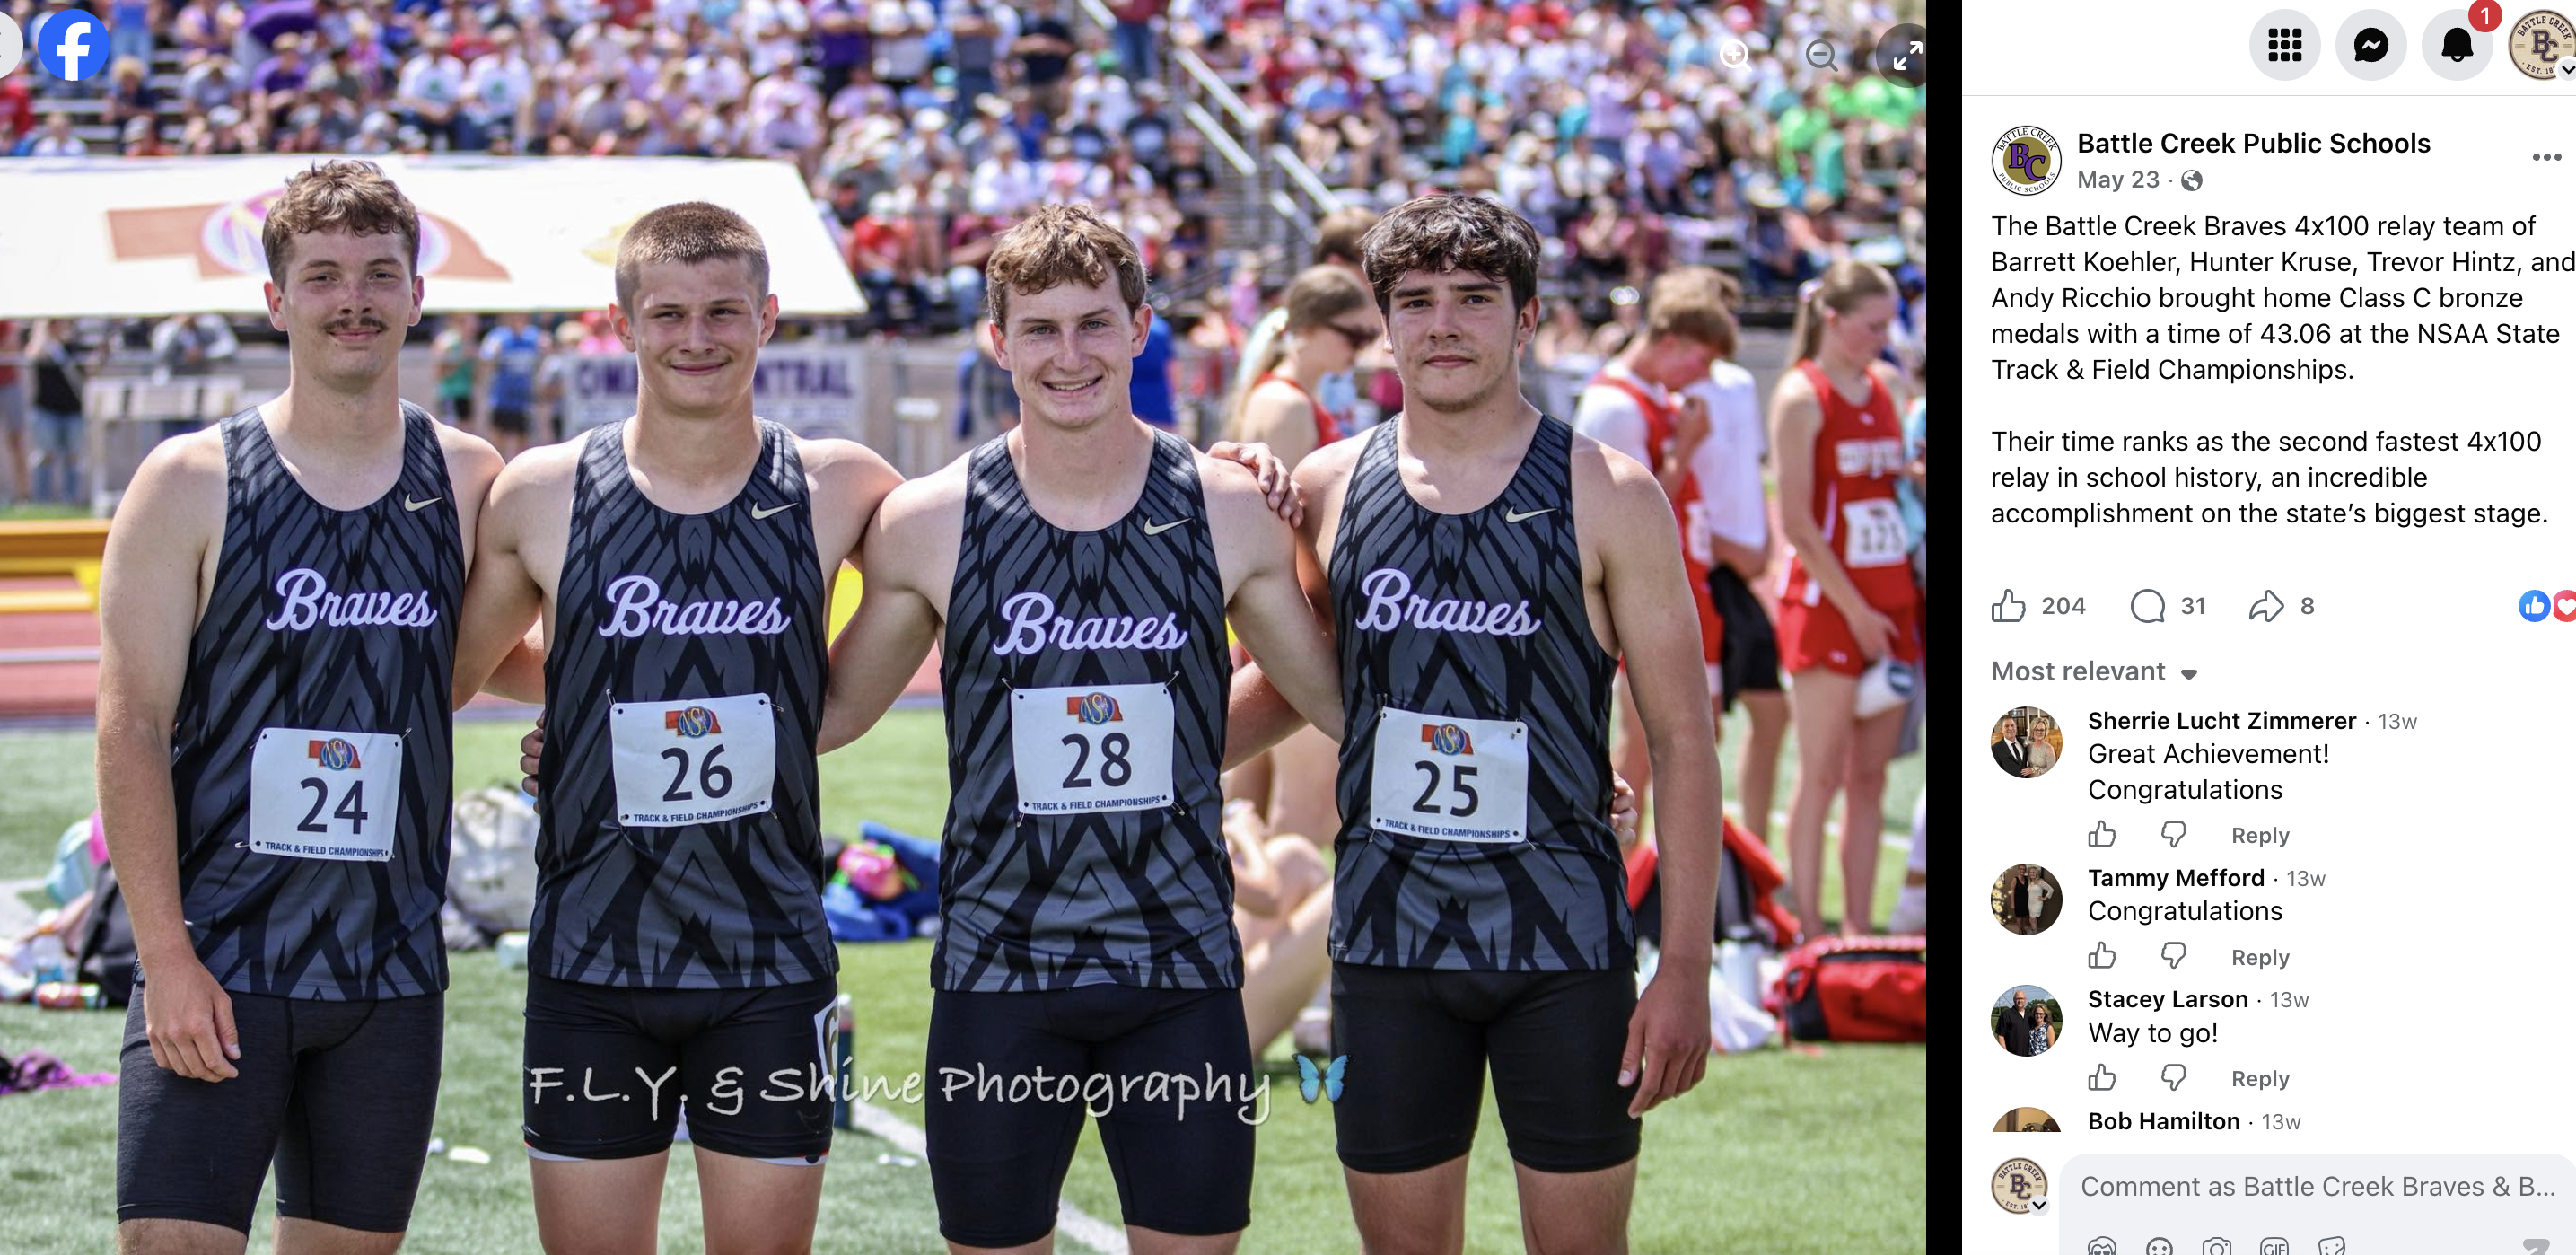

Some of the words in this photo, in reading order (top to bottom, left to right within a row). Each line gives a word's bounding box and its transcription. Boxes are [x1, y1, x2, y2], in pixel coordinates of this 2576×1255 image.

[2481, 7, 2489, 25] 1
[2517, 15, 2546, 37] BATTLE
[2549, 17, 2572, 40] CREEK
[57, 22, 91, 81] f
[2531, 29, 2559, 63] BC
[2526, 64, 2542, 75] EST.
[2545, 66, 2555, 75] 18
[1996, 127, 2028, 152] BATTLE
[2030, 128, 2057, 151] CREEK
[2079, 132, 2152, 154] Battle
[2161, 132, 2236, 154] Creek
[2245, 132, 2321, 154] Public
[2330, 132, 2431, 154] Schools
[2009, 143, 2046, 181] BC
[1999, 172, 2022, 192] PUBLIC
[2024, 171, 2055, 193] SCHOOLS
[2079, 171, 2124, 192] May
[2132, 171, 2160, 188] 23
[1992, 215, 2037, 236] The
[2047, 215, 2116, 236] Battle
[2125, 215, 2196, 236] Creek
[2205, 215, 2286, 236] Braves
[2295, 215, 2369, 236] 4x100
[2379, 215, 2435, 241] relay
[2443, 217, 2503, 236] team
[2513, 215, 2537, 236] of
[1993, 251, 2075, 272] Barrett
[2085, 251, 2180, 276] Koehler,
[2191, 252, 2274, 272] Hunter
[2282, 252, 2357, 276] Kruse,
[2367, 252, 2444, 272] Trevor
[2453, 250, 2521, 276] Hintz,
[2531, 251, 2575, 272] and
[1992, 287, 2054, 312] Andy
[2063, 286, 2151, 308] Ricchio
[2160, 287, 2255, 312] brought
[2265, 287, 2331, 308] home
[2340, 287, 2405, 308] Class
[2414, 287, 2431, 308] C
[2440, 287, 2523, 308] bronze
[1993, 323, 2079, 344] medals
[2088, 322, 2136, 343] with
[2146, 329, 2159, 344] a
[2168, 322, 2220, 344] time
[2229, 323, 2252, 344] of
[2261, 323, 2330, 344] 43.06
[2340, 325, 2362, 344] at
[2370, 323, 2409, 344] the
[2419, 323, 2488, 344] NSAA
[2497, 323, 2560, 344] State
[1992, 359, 2058, 380] Track
[2067, 359, 2084, 380] &
[2094, 358, 2149, 380] Field
[2159, 358, 2353, 384] Championships.
[1992, 430, 2054, 452] Their
[2062, 430, 2114, 452] time
[2124, 431, 2188, 452] ranks
[2197, 436, 2223, 452] as
[2231, 431, 2270, 452] the
[2279, 431, 2367, 452] second
[2376, 431, 2458, 452] fastest
[2467, 431, 2541, 452] 4x100
[1993, 467, 2049, 492] relay
[2058, 466, 2077, 487] in
[2087, 467, 2165, 487] school
[2176, 466, 2261, 492] history,
[2272, 472, 2299, 487] an
[2309, 466, 2427, 487] incredible
[1992, 502, 2193, 528] accomplishment
[2202, 508, 2230, 523] on
[2239, 503, 2277, 523] the
[2287, 504, 2366, 523] state’s
[2376, 503, 2466, 528] biggest
[2474, 505, 2547, 528] stage.
[267, 567, 438, 631] Braves
[598, 575, 792, 638] Braves
[1355, 567, 1542, 636] Braves
[2043, 597, 2086, 615] 204
[2181, 597, 2204, 614] 31
[2301, 597, 2314, 614] 8
[993, 592, 1188, 656] Braves
[1993, 662, 2055, 680] Most
[2063, 661, 2165, 680] relevant
[2089, 711, 2169, 730] Sherrie
[2178, 711, 2240, 730] Lucht
[2248, 711, 2357, 730] Zimmerer
[2379, 714, 2417, 729] 13w
[1061, 732, 1132, 789] 28
[2090, 743, 2155, 764] Great
[2163, 742, 2328, 764] Achievement!
[660, 743, 732, 803] 26
[1412, 760, 1479, 818] 25
[2090, 779, 2282, 804] Congratulations
[297, 777, 368, 835] 24
[634, 813, 661, 823] TRACK
[662, 813, 670, 823] &
[670, 812, 694, 822] FIELD
[696, 801, 758, 821] CHAMPIONSHIPS
[1032, 802, 1059, 812] TRACK
[1061, 802, 1068, 811] &
[1070, 800, 1092, 810] FIELD
[1095, 795, 1161, 809] CHAMPIONSHIPS
[1385, 819, 1409, 832] TRACK
[1410, 823, 1417, 833] &
[1418, 825, 1440, 836] FIELD
[1441, 827, 1511, 838] CHAMPIONSHIPS
[2233, 827, 2290, 847] Reply
[266, 841, 293, 852] TRACK
[294, 844, 301, 853] &
[302, 845, 327, 855] FIELD
[329, 847, 384, 857] CHAMPIONSHIPS
[2089, 869, 2169, 891] Tammy
[2177, 868, 2264, 887] Mefford
[2288, 871, 2326, 886] 13w
[2090, 900, 2282, 926] Congratulations
[2233, 949, 2290, 970] Reply
[2089, 990, 2165, 1012] Stacey
[2173, 990, 2247, 1008] Larson
[2271, 992, 2309, 1007] 13w
[2089, 1023, 2140, 1048] Way
[2148, 1024, 2171, 1043] to
[2180, 1023, 2217, 1048] go!
[2233, 1070, 2290, 1091] Reply
[2090, 1111, 2132, 1130] Bob
[2140, 1111, 2239, 1130] Hamilton
[2263, 1114, 2300, 1129] 13w
[1998, 1163, 2022, 1180] BATTLE
[2023, 1163, 2042, 1182] CREEK
[2082, 1176, 2200, 1197] Comment
[2209, 1181, 2235, 1196] as
[2246, 1176, 2314, 1196] Battle
[2324, 1176, 2394, 1197] Creek
[2404, 1177, 2484, 1196] Braves
[2493, 1176, 2510, 1196] &
[2520, 1177, 2554, 1196] B...
[2264, 1244, 2285, 1255] GIF
